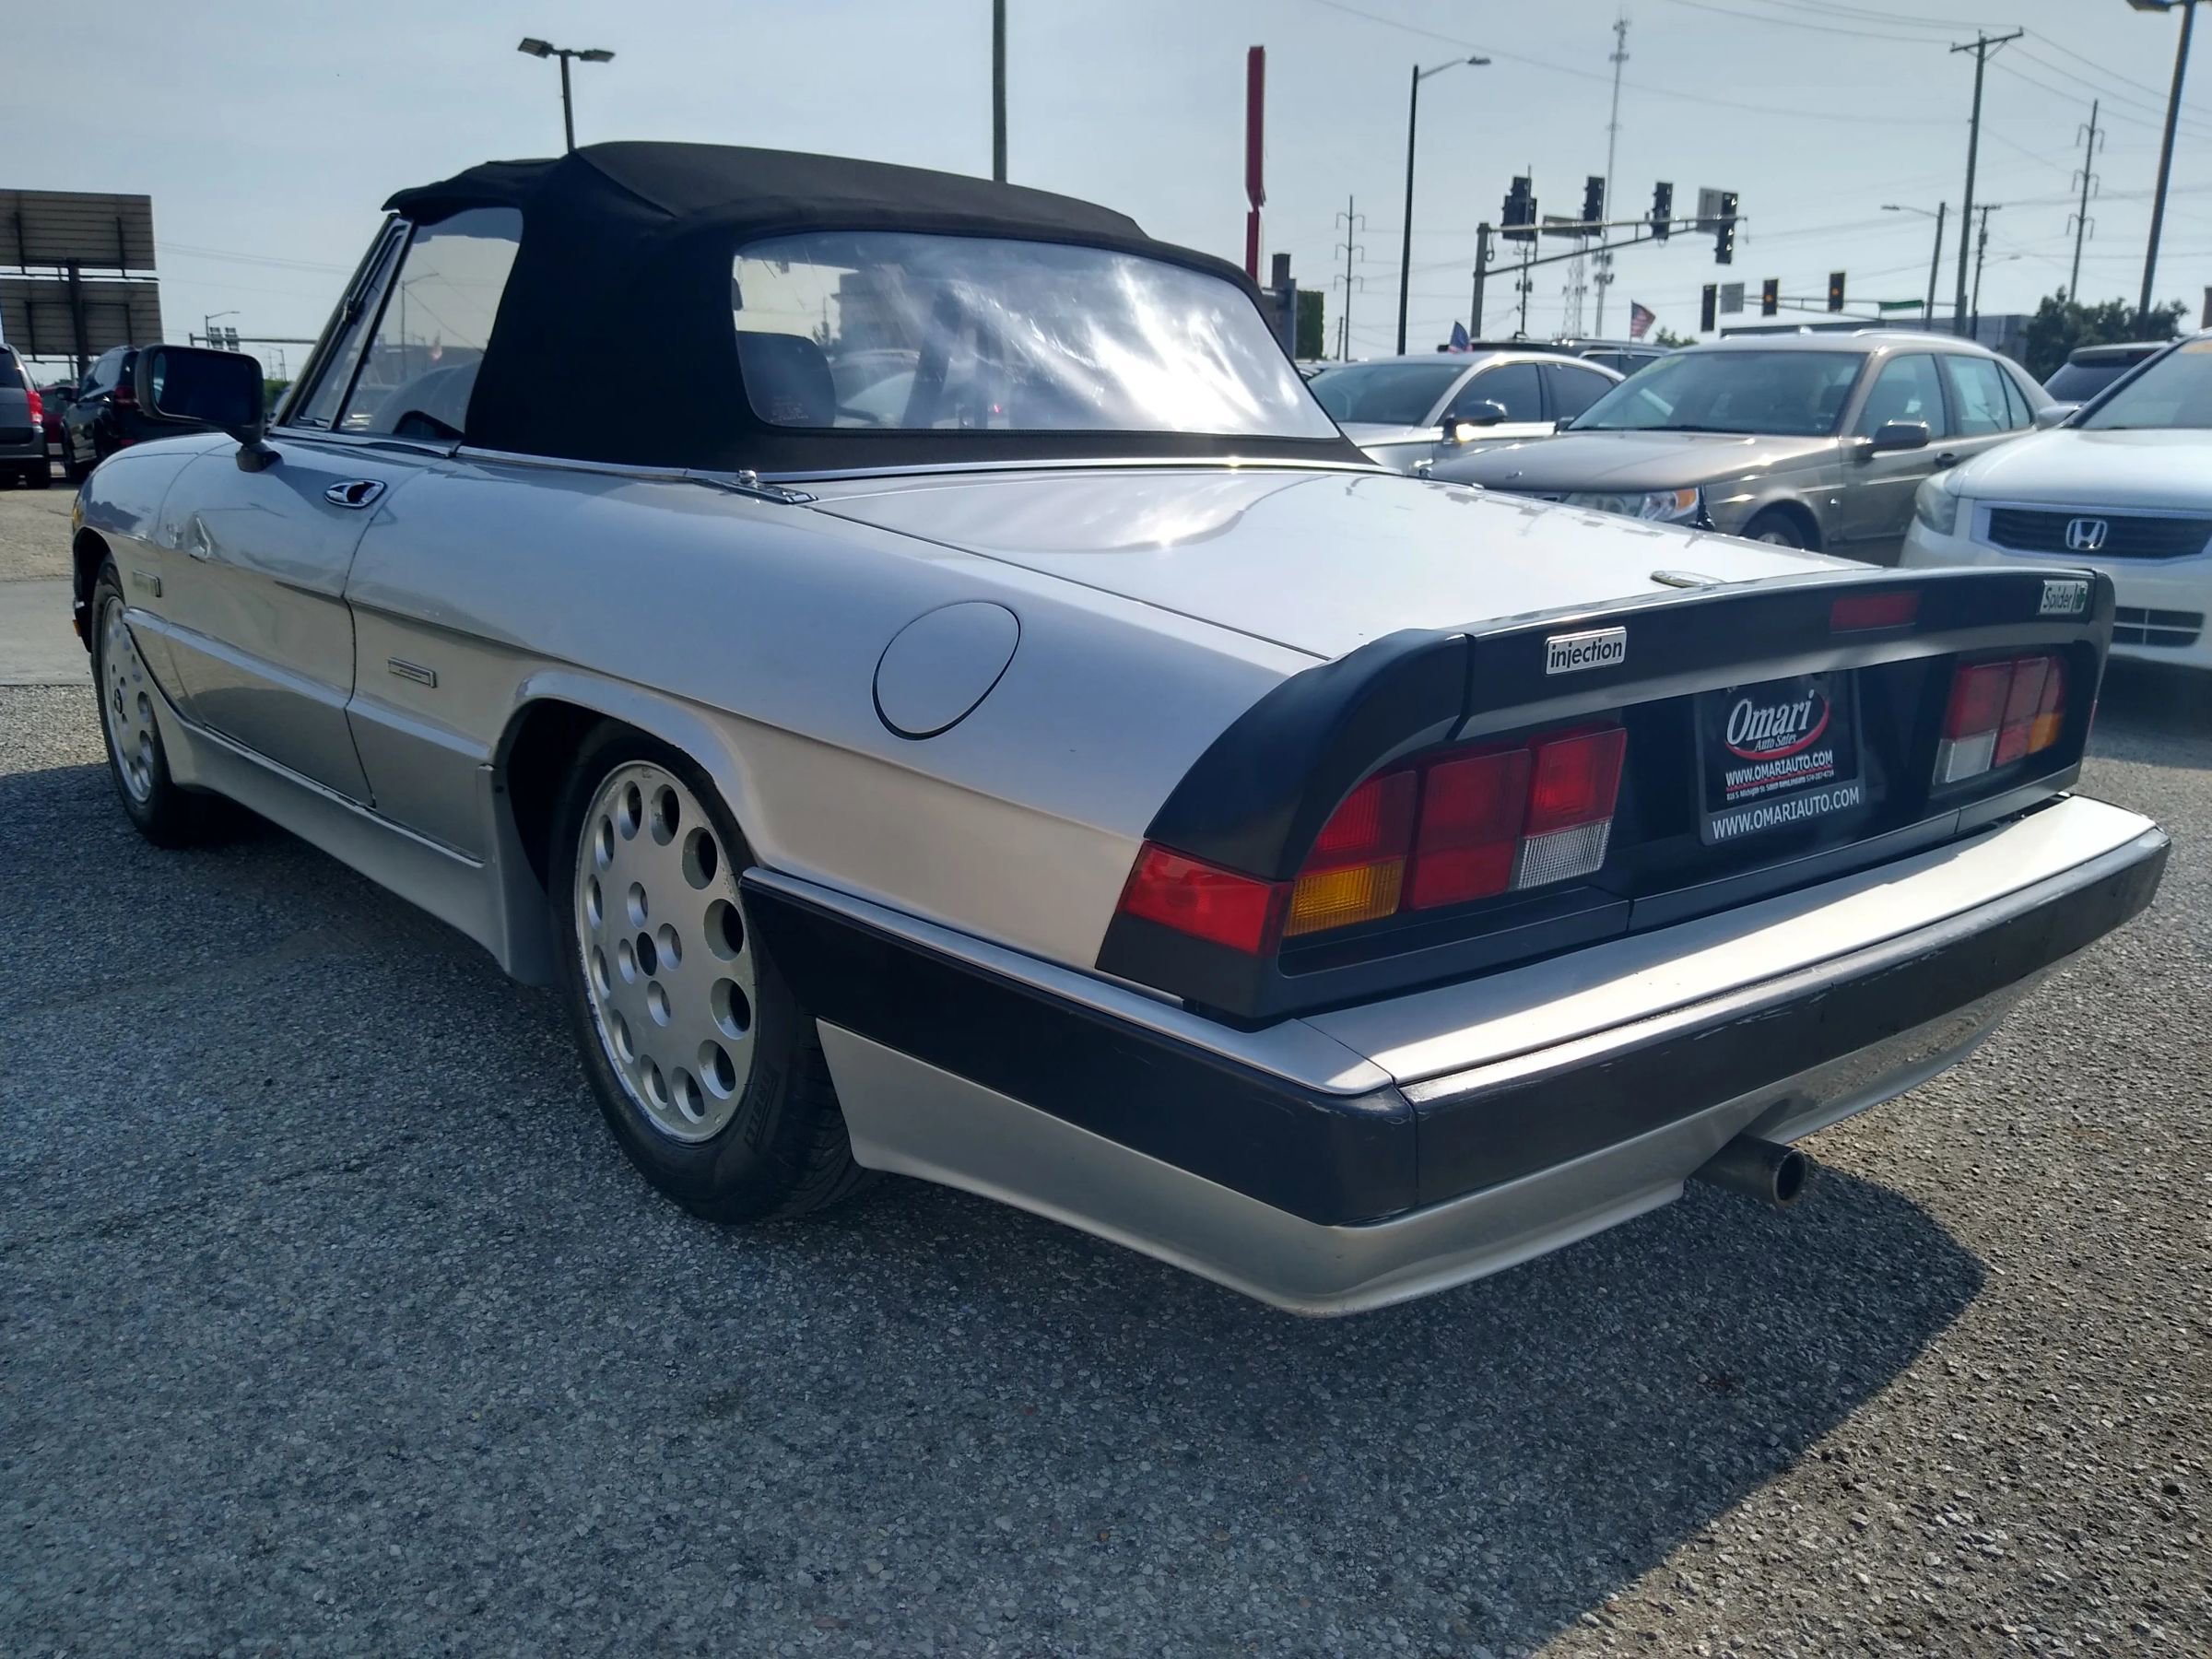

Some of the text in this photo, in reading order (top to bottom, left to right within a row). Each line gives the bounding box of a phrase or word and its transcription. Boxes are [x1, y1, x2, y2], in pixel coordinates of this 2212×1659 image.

[2042, 586, 2073, 609] Spider
[1550, 637, 1622, 668] injection
[1726, 688, 1815, 745] Omari
[1754, 733, 1797, 752] Auto Sales
[1725, 749, 1833, 787] WWW.OMARIAUTO.COM
[1712, 786, 1860, 840] WWW.OMARIAUTO.COM
